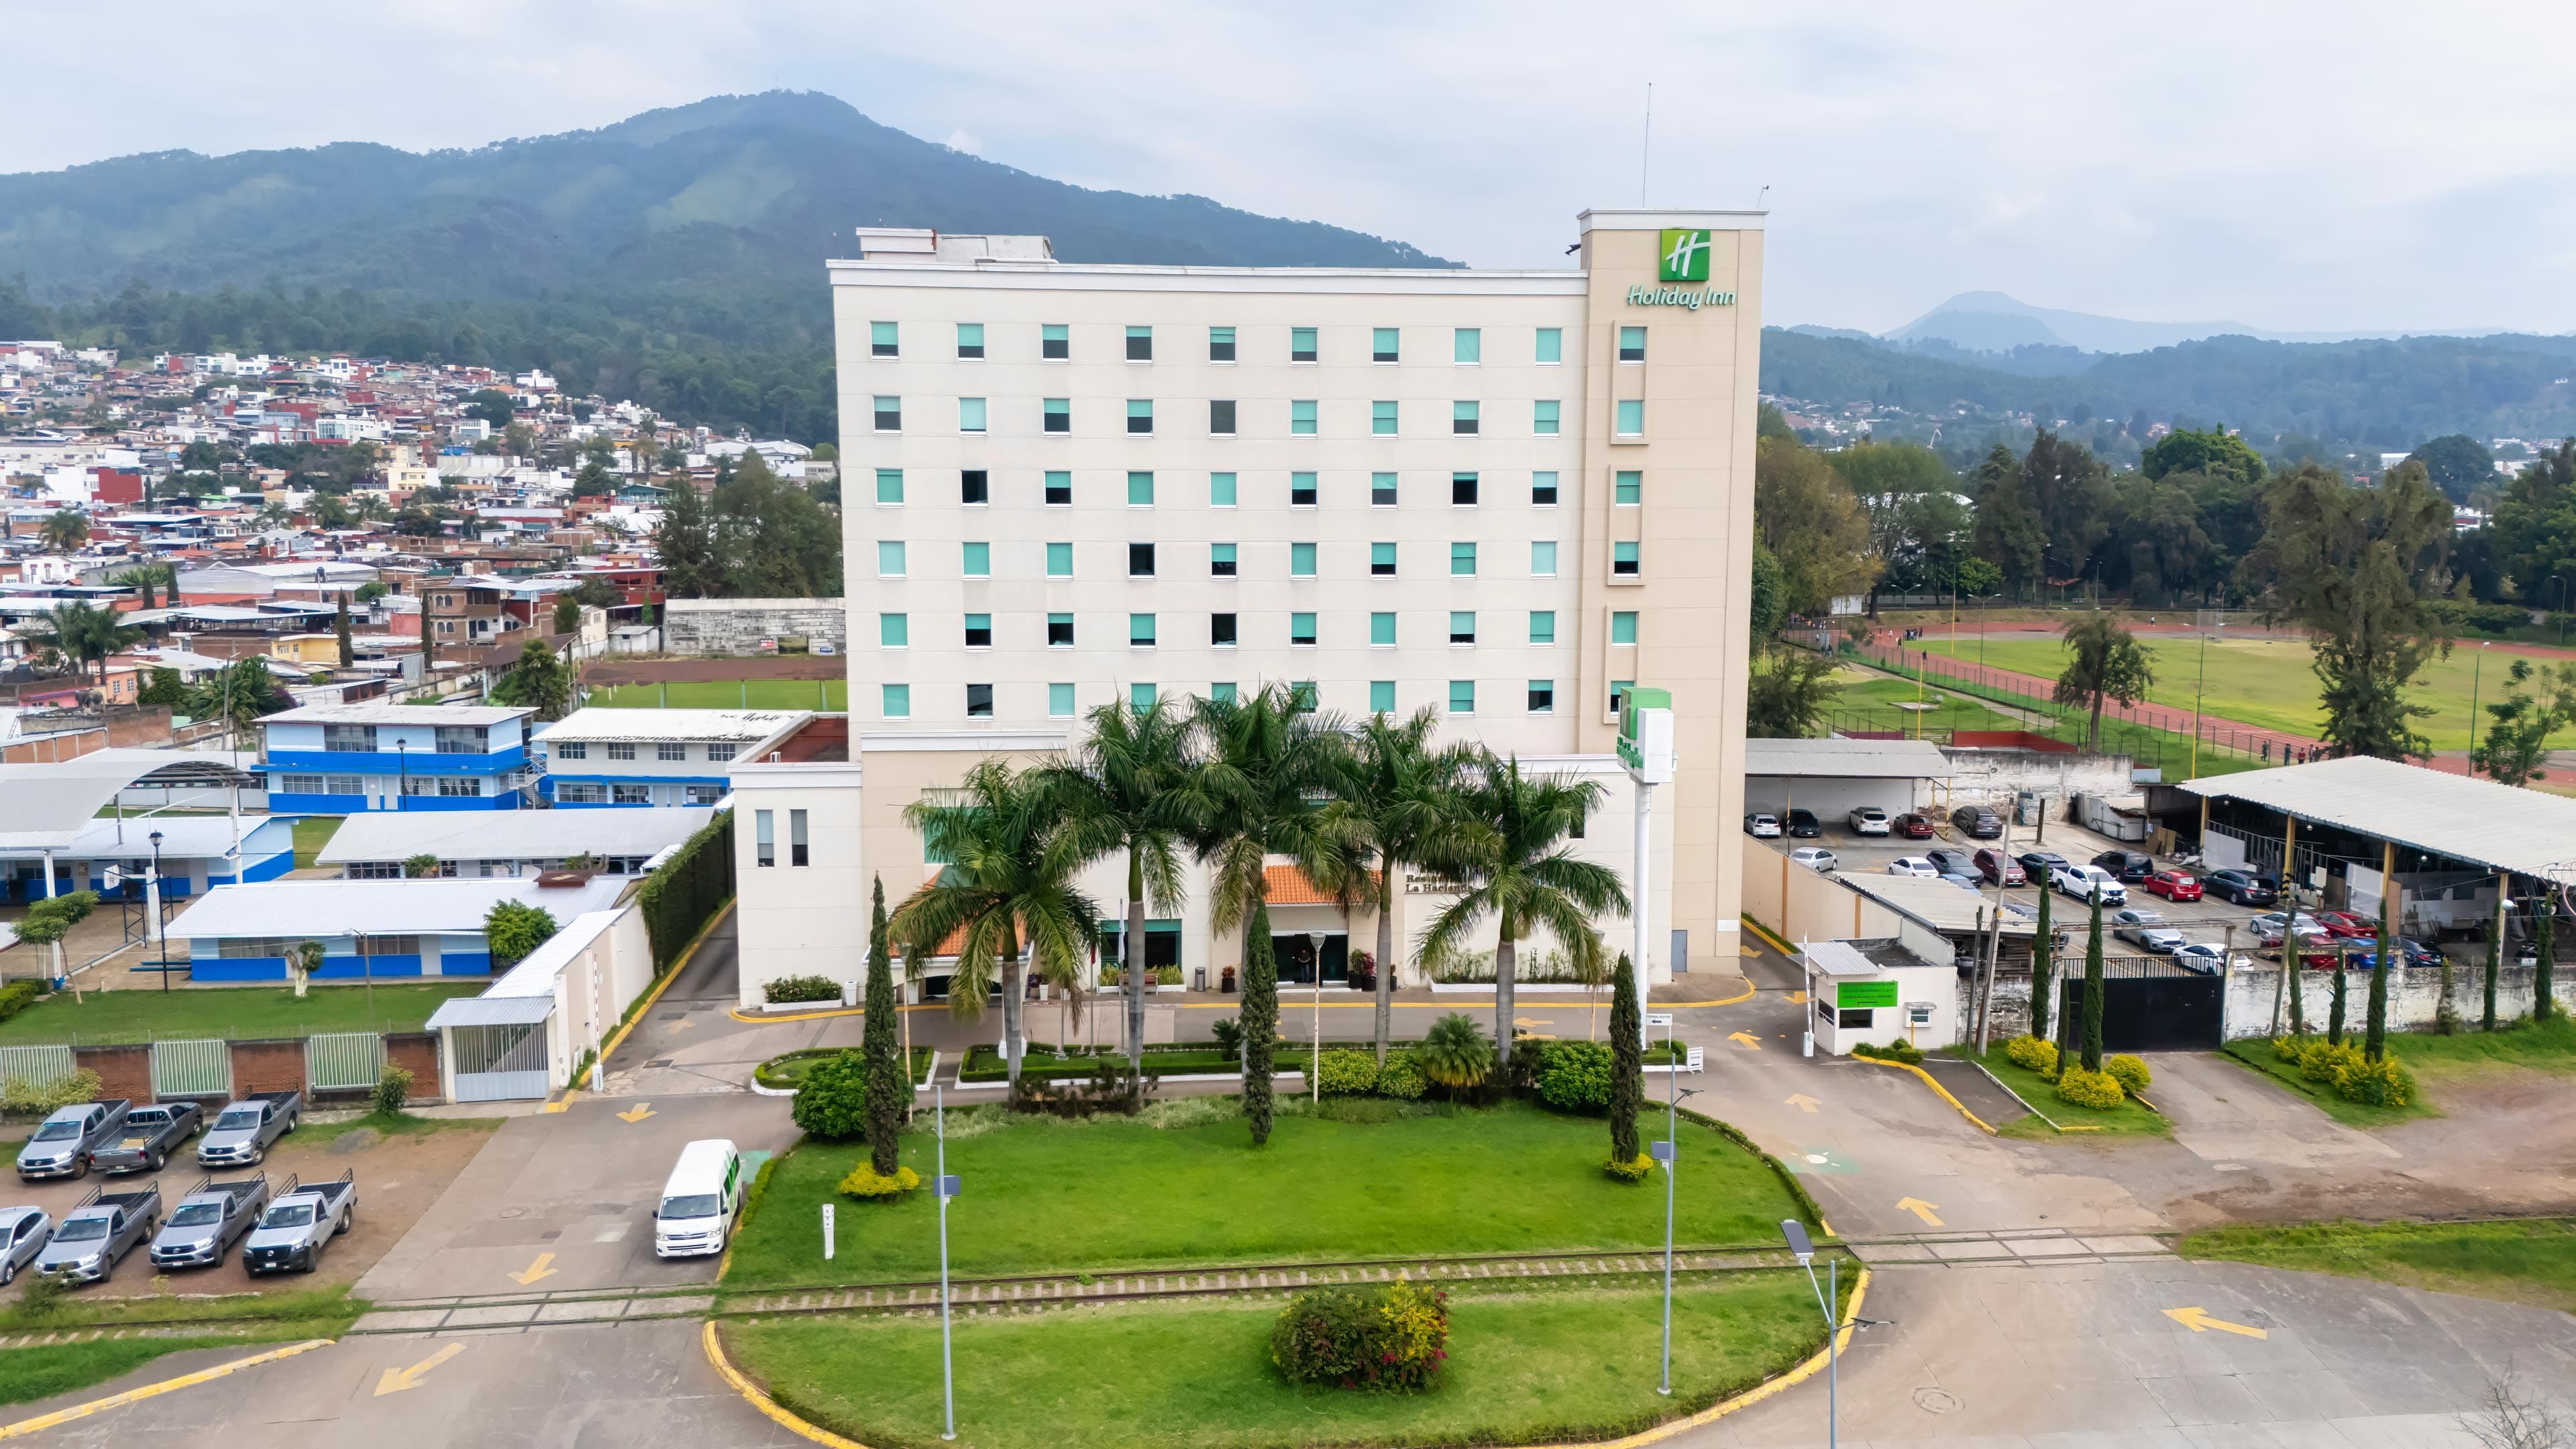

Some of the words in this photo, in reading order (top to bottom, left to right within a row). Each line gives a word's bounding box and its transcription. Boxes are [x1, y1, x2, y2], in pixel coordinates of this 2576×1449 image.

[1627, 284, 1703, 311] Holiday
[1705, 284, 1736, 306] Inn
[1405, 883, 1420, 892] La
